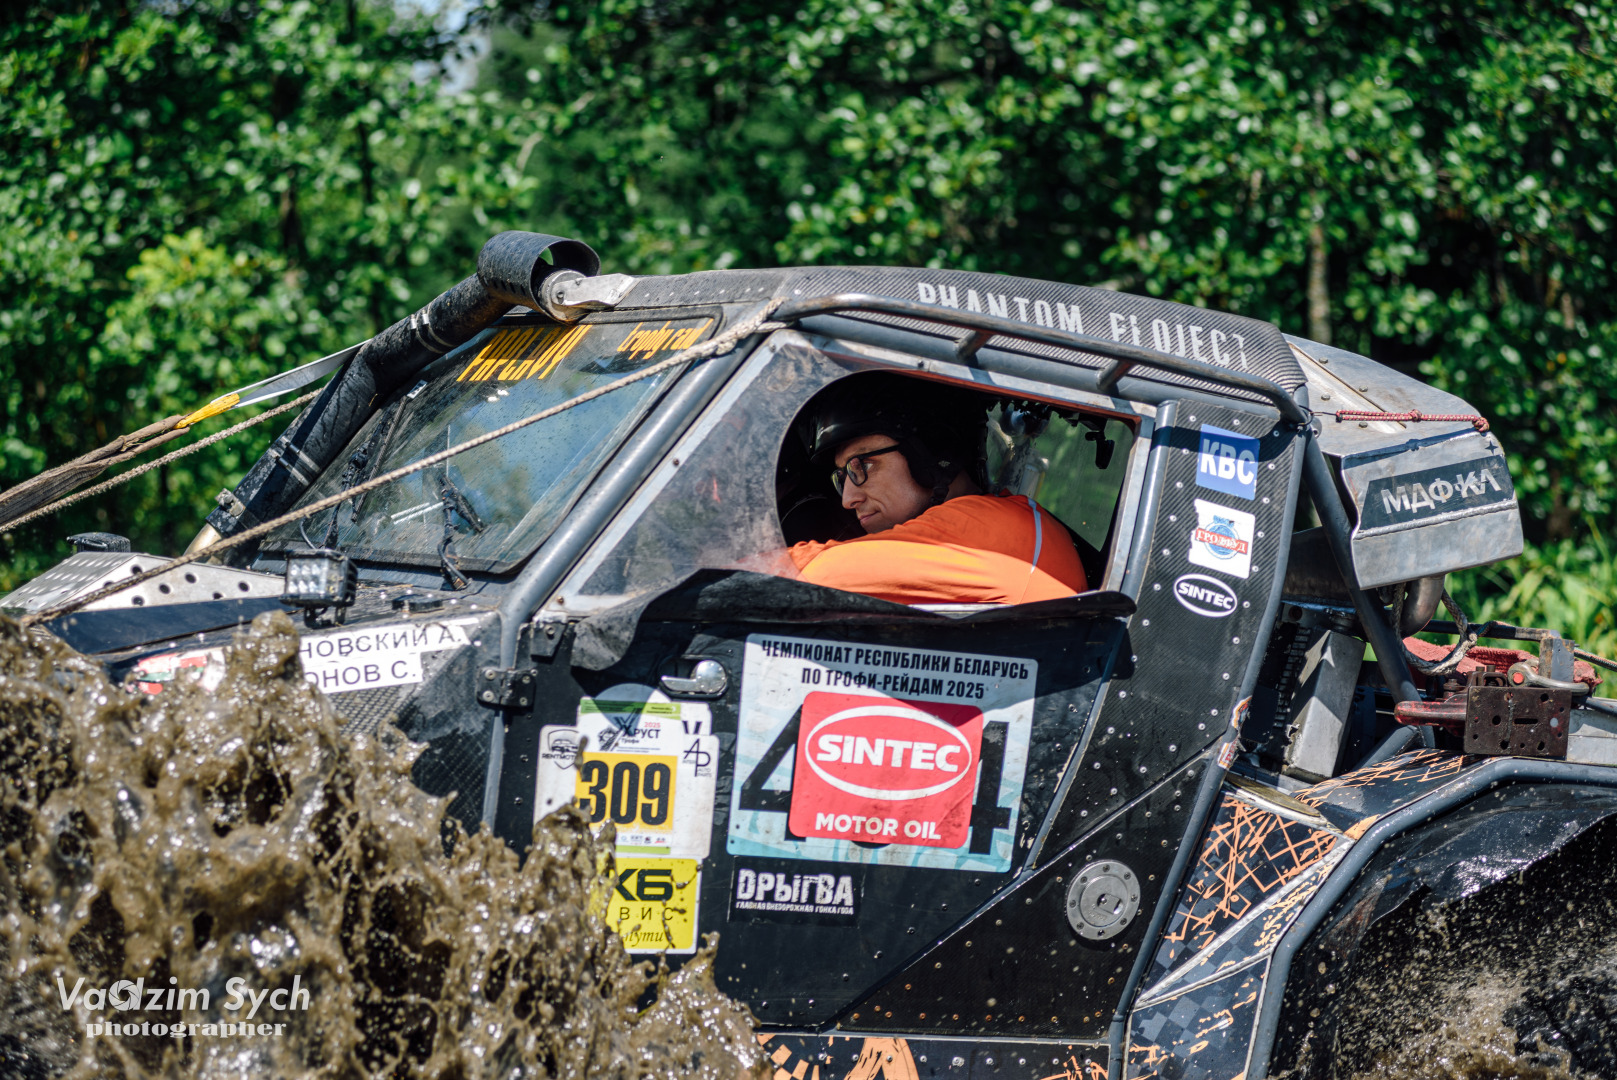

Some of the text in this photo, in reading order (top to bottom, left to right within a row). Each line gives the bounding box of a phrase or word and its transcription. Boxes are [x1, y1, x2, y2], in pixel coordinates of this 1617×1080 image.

[917, 282, 1084, 335] PHANTOM
[617, 318, 714, 360] trophy raid
[1178, 582, 1233, 610] SINTEC
[391, 661, 416, 680] С.
[761, 640, 1029, 680] ЧЕМПИОНАТ РЕСПУБЛИКИ БЕЛАРУСЬ
[801, 667, 985, 699] ПО ТРОФИ-РЕЙДАМ 2025
[643, 721, 661, 729] 2025
[816, 733, 961, 773] SINTEC
[580, 760, 671, 826] 309
[815, 812, 941, 840] MOTOR OIL
